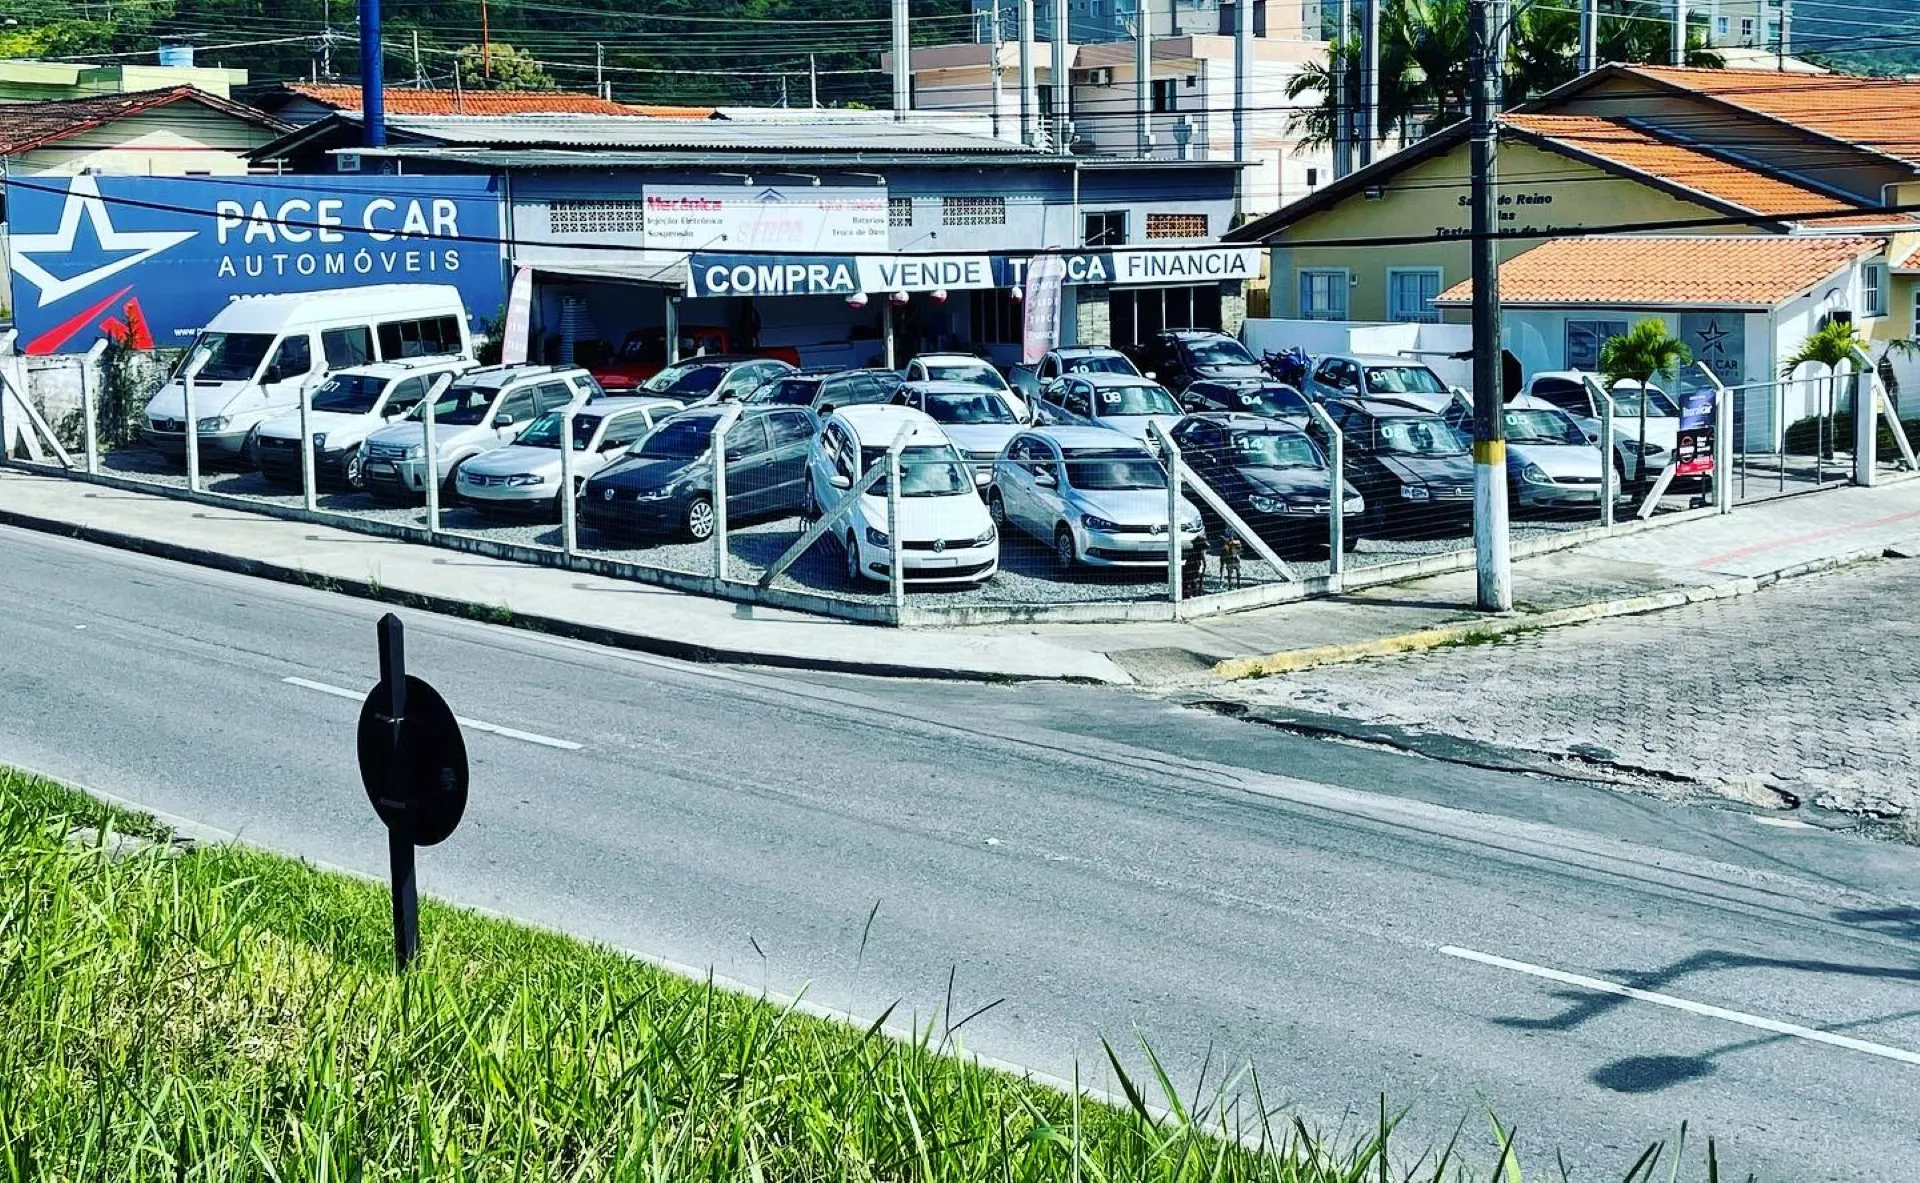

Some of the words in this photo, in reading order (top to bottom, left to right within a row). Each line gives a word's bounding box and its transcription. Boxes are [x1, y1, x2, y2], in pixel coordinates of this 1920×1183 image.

[1516, 193, 1553, 205] Reino
[216, 200, 344, 244] PACE
[363, 199, 459, 242] CAR
[218, 248, 460, 278] AUTOMÓVEIS
[705, 264, 854, 292] COMPRA
[879, 261, 981, 286] VENDE
[1128, 253, 1247, 277] FINANCIA
[1241, 396, 1262, 406] 04
[1238, 436, 1262, 450] 14
